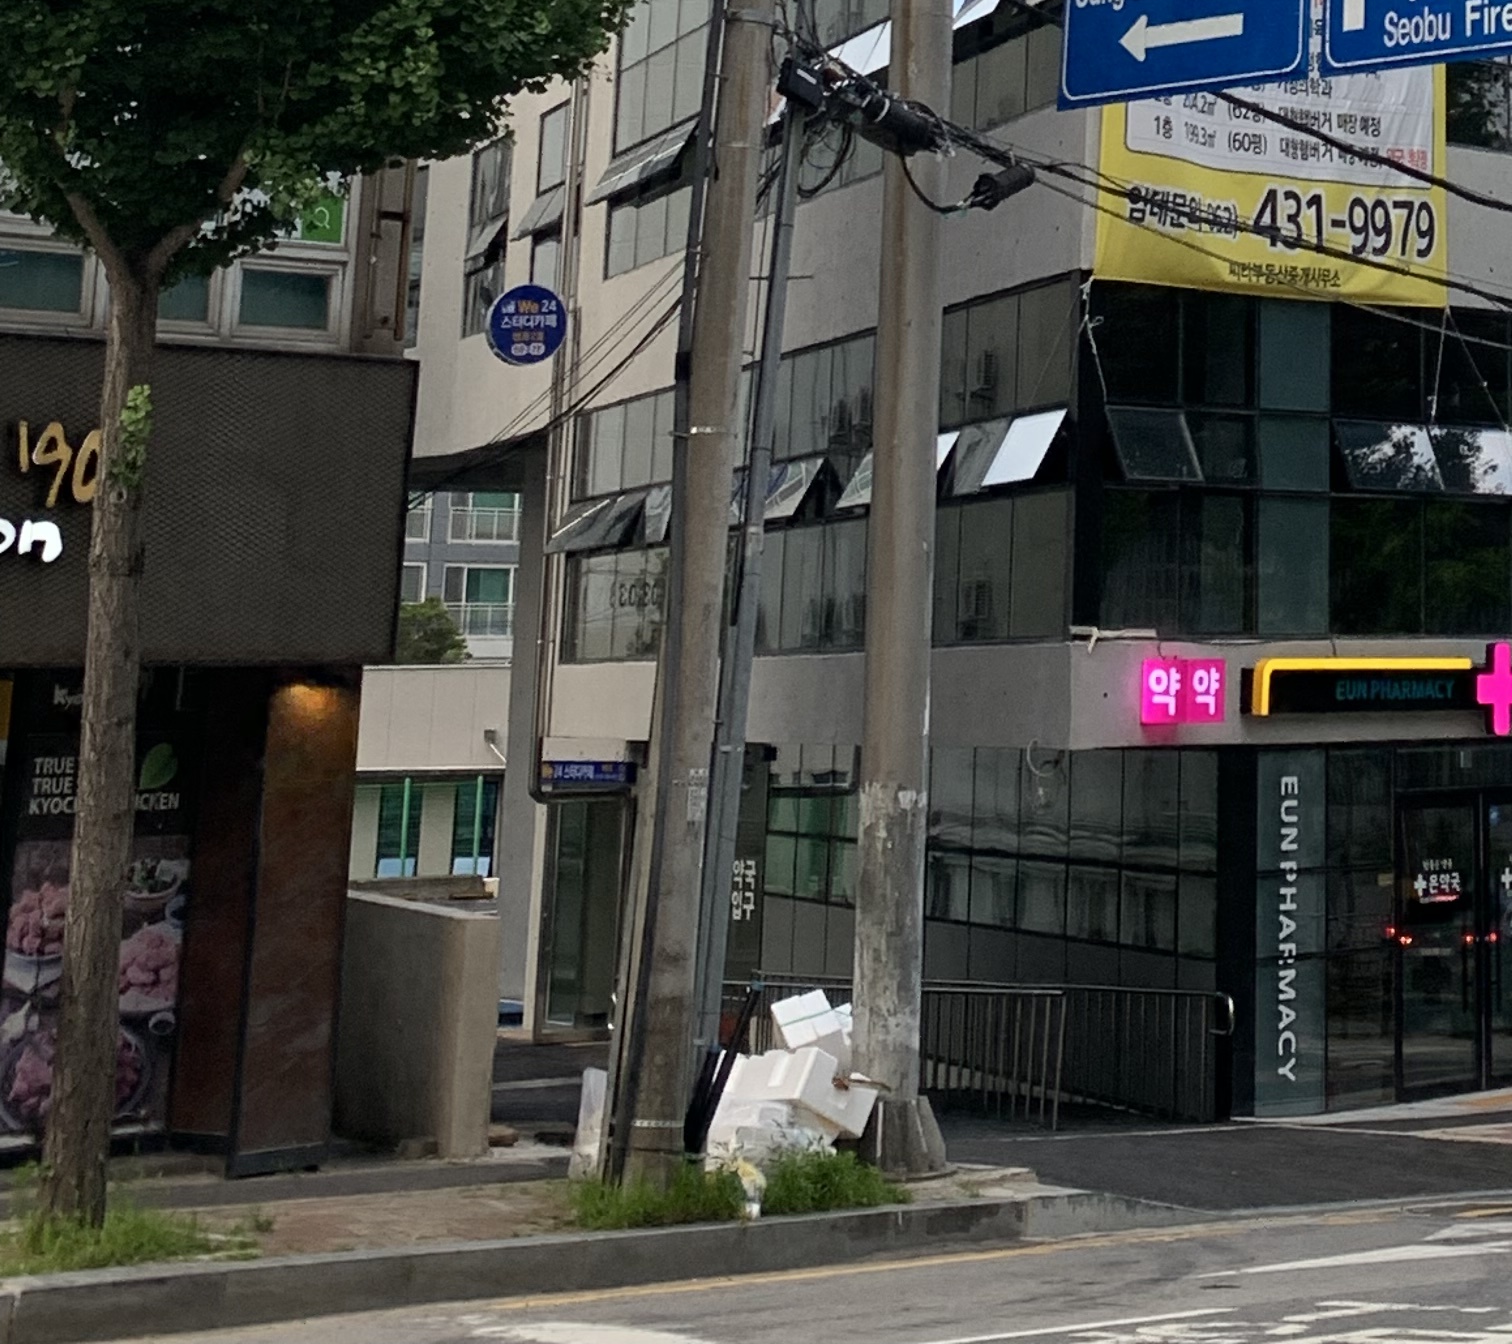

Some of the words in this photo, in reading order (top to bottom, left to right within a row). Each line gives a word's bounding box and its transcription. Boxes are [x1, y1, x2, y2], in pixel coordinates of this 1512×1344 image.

[1384, 5, 1451, 49] Seobu
[1153, 115, 1174, 140] 1층
[1227, 132, 1269, 157] (60평)
[1253, 187, 1436, 260] 431-9979
[500, 314, 558, 329] 스터디카페
[541, 299, 558, 313] 24
[1147, 666, 1181, 717] 약
[1191, 665, 1220, 716] 약
[1335, 678, 1367, 701] EUN
[1369, 675, 1455, 700] PHARMACY
[32, 756, 75, 776] TRUE
[31, 776, 74, 796] TRUE
[1280, 775, 1298, 852] EUN
[732, 859, 756, 890] 약국
[1428, 871, 1461, 895] 은약국
